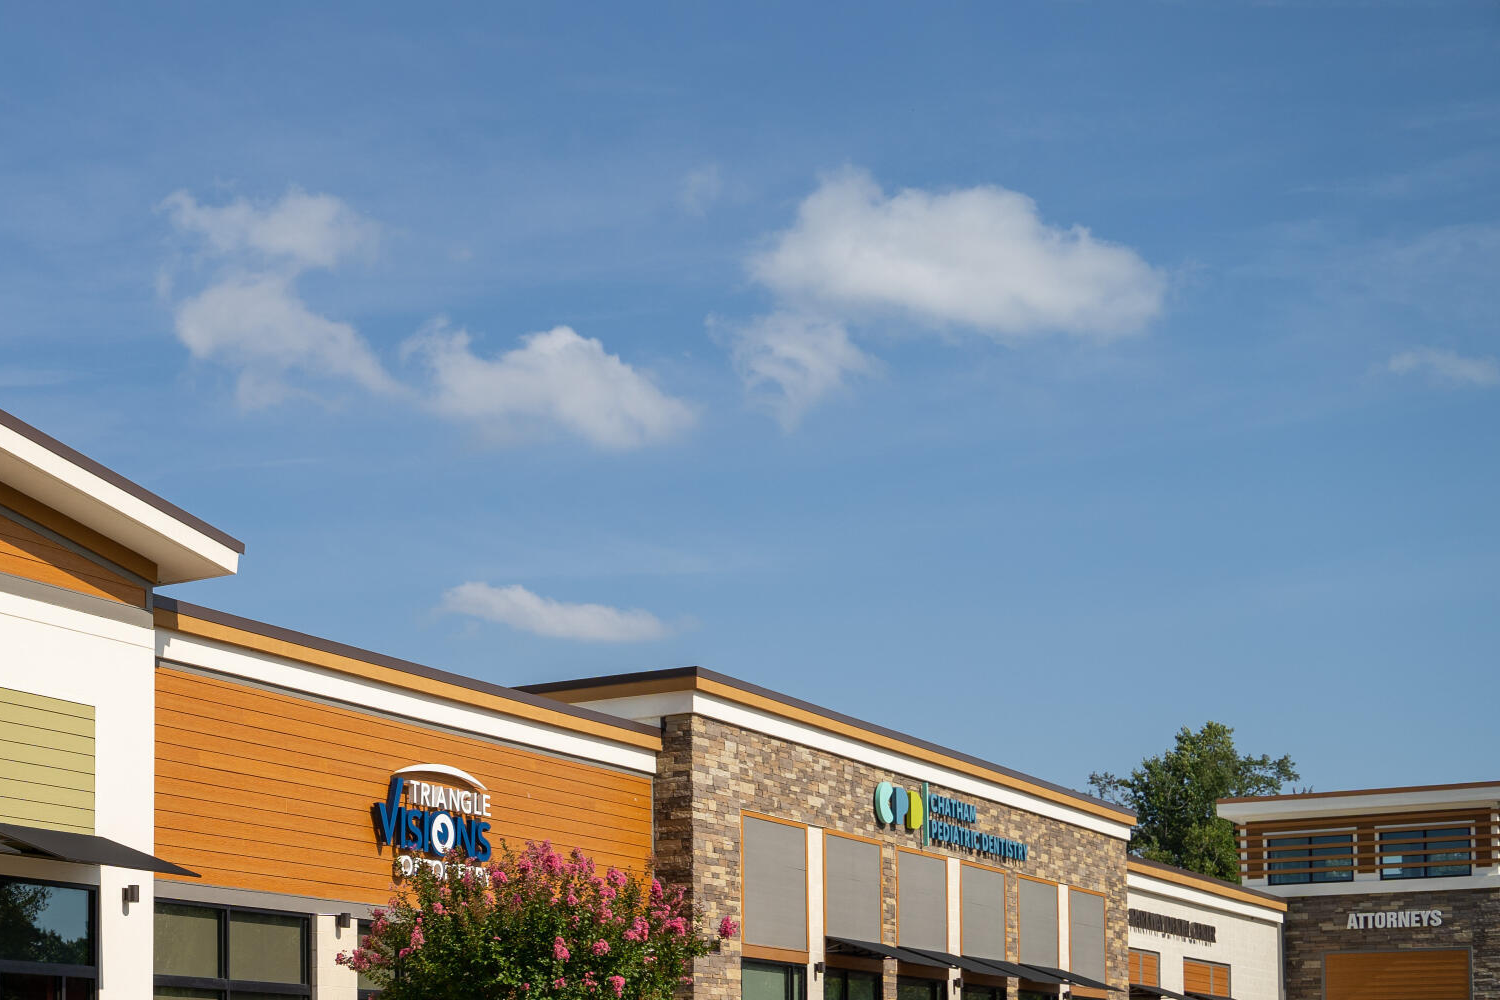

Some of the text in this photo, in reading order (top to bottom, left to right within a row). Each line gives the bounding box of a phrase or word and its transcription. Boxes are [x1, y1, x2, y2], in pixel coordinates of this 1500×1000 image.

[408, 780, 492, 817] TRIANGLE
[930, 794, 977, 824] CHATHAM
[374, 777, 492, 862] VISIONS
[929, 819, 1029, 862] PEDIATRIC DENTISTRY
[1347, 909, 1442, 930] ATTORNEYS
